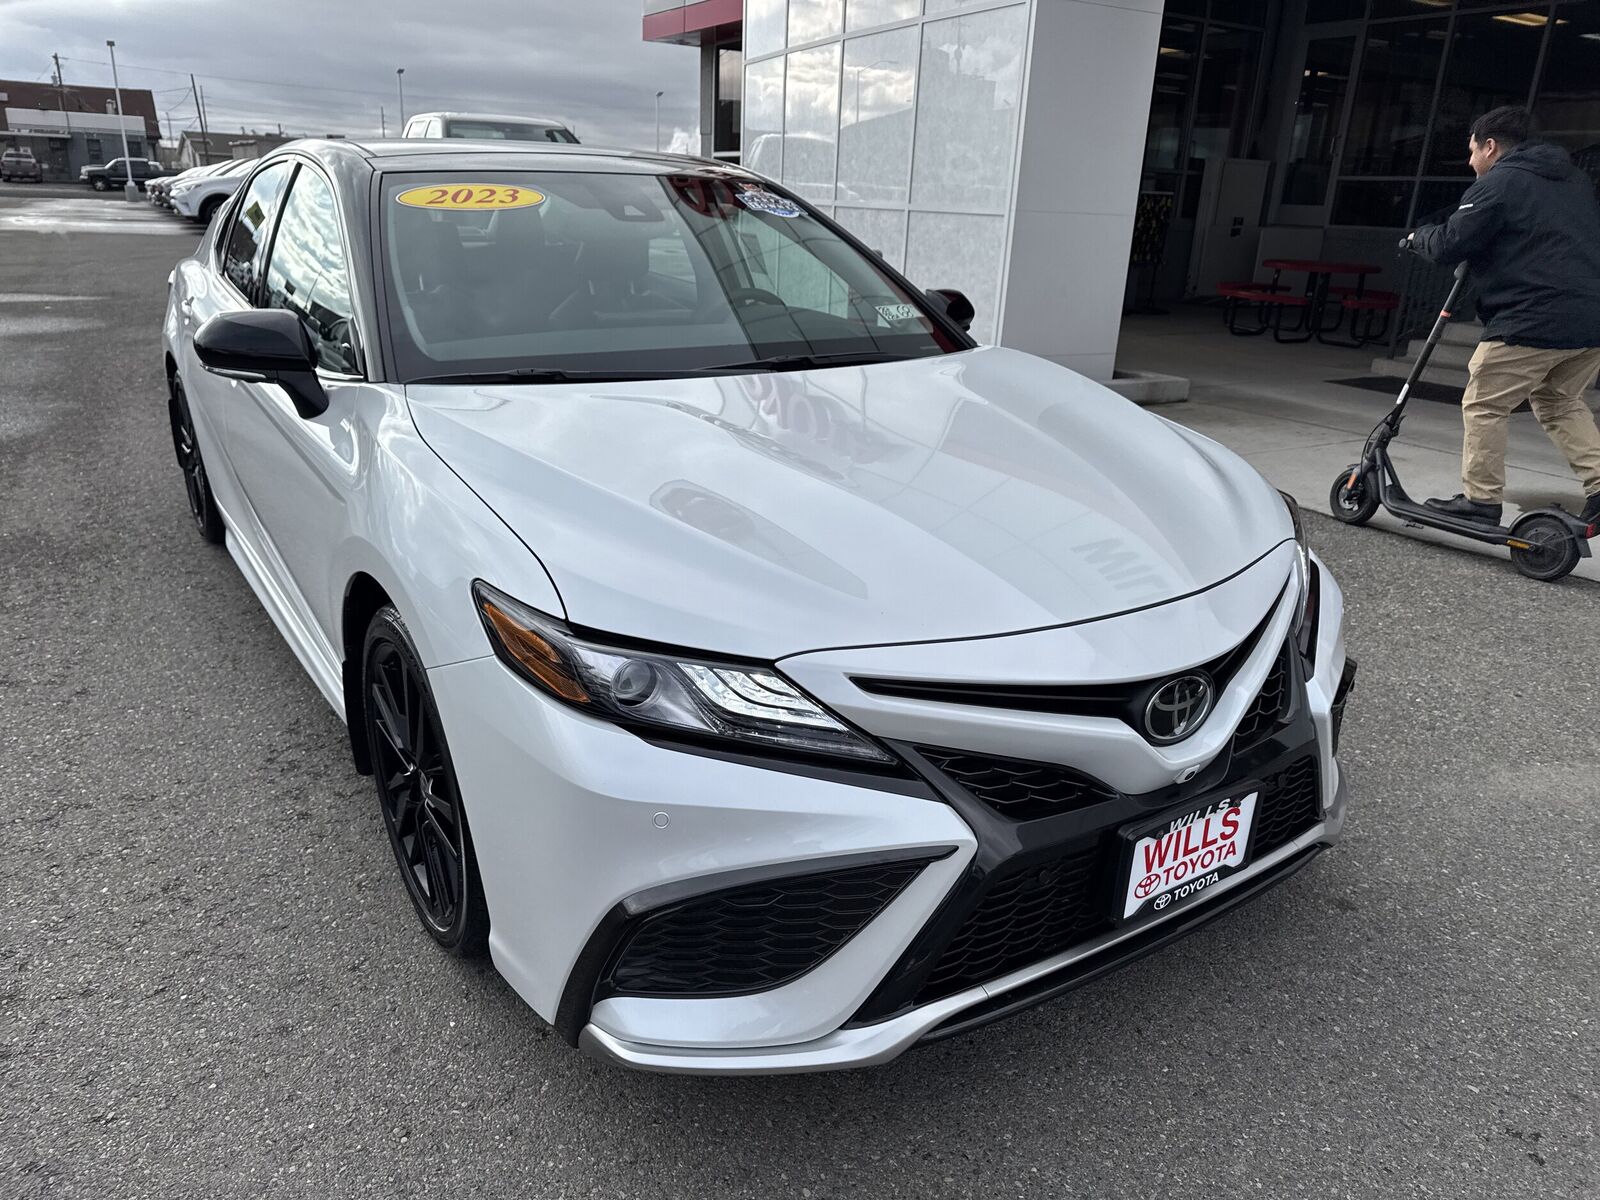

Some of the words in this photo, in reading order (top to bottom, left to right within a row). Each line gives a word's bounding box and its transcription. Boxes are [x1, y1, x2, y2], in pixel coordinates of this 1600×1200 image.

[425, 188, 520, 205] 2023
[1170, 798, 1231, 832] WILLS
[1144, 807, 1241, 874] WILLS
[1163, 840, 1237, 886] TOYOTA
[1174, 872, 1219, 900] TOYOTA
